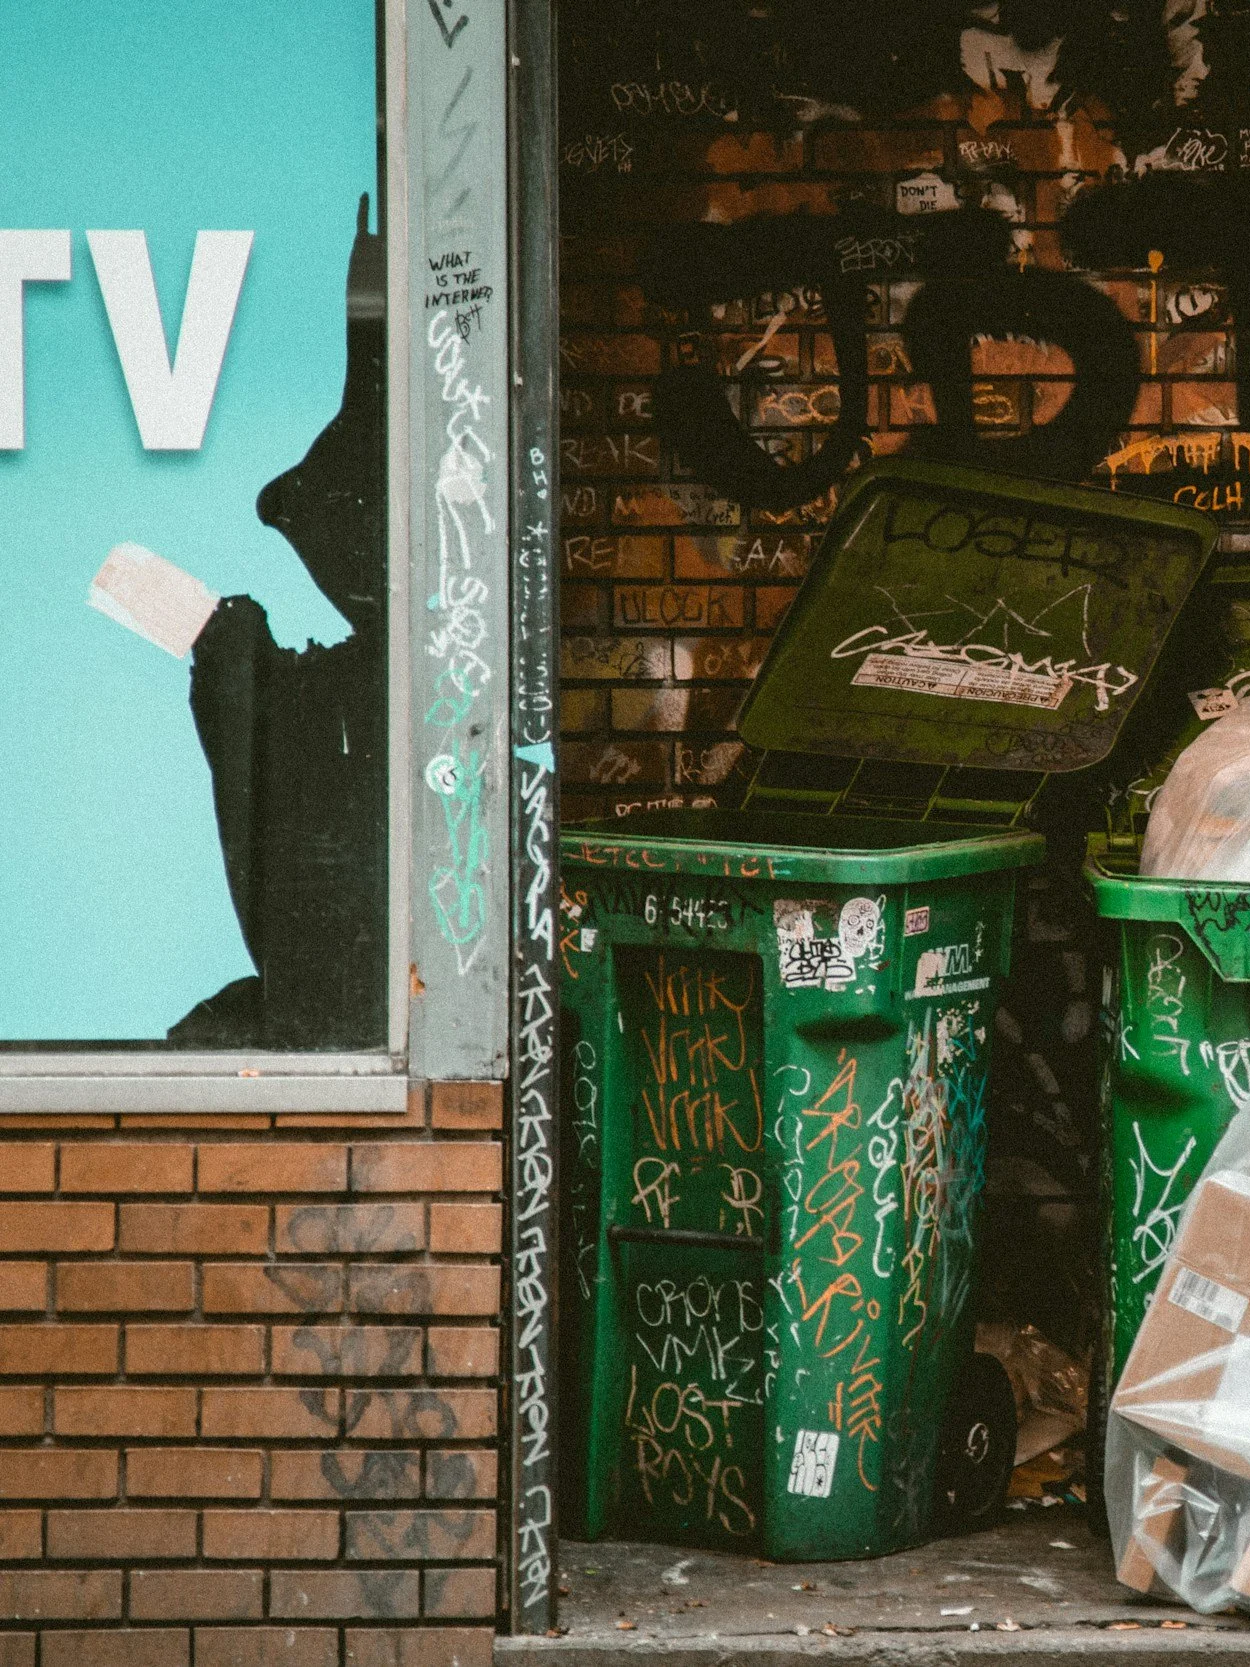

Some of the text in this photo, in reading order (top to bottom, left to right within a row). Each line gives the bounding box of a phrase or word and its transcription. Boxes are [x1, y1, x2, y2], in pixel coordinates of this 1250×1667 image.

[901, 184, 938, 198] DON'T
[919, 200, 938, 212] DIE
[429, 251, 471, 271] WHAT
[453, 268, 481, 285] THE
[875, 675, 926, 687] CAUTION
